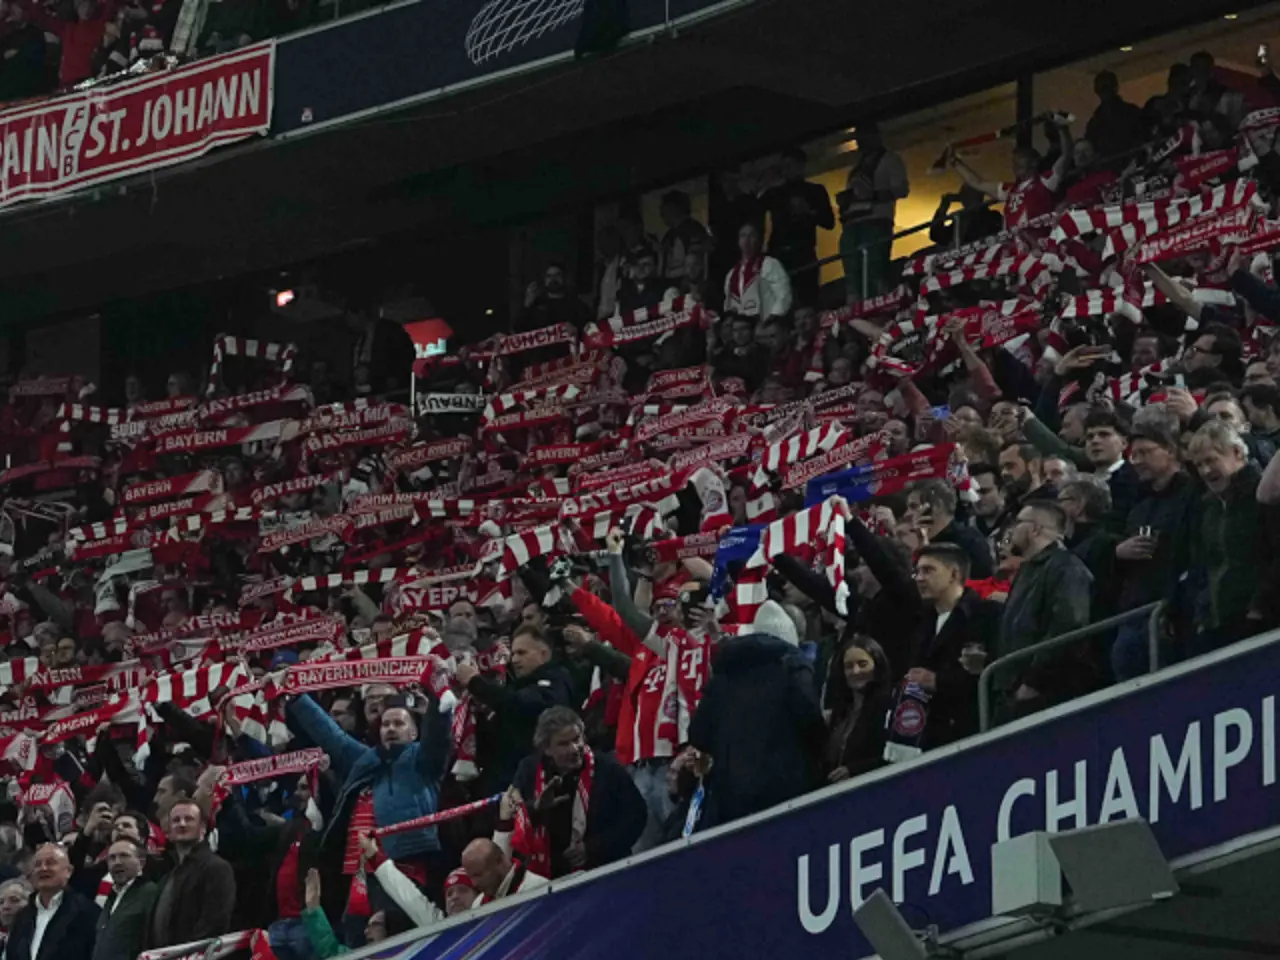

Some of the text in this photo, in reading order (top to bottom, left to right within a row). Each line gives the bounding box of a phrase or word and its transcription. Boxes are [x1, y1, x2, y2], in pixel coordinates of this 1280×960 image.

[85, 112, 130, 159] ST.
[136, 66, 261, 141] JOHANN
[165, 427, 228, 450] BAYERN
[31, 666, 83, 686] AYERN
[299, 655, 430, 687] BAYERN MÜNCHEN
[797, 803, 975, 936] UEFA
